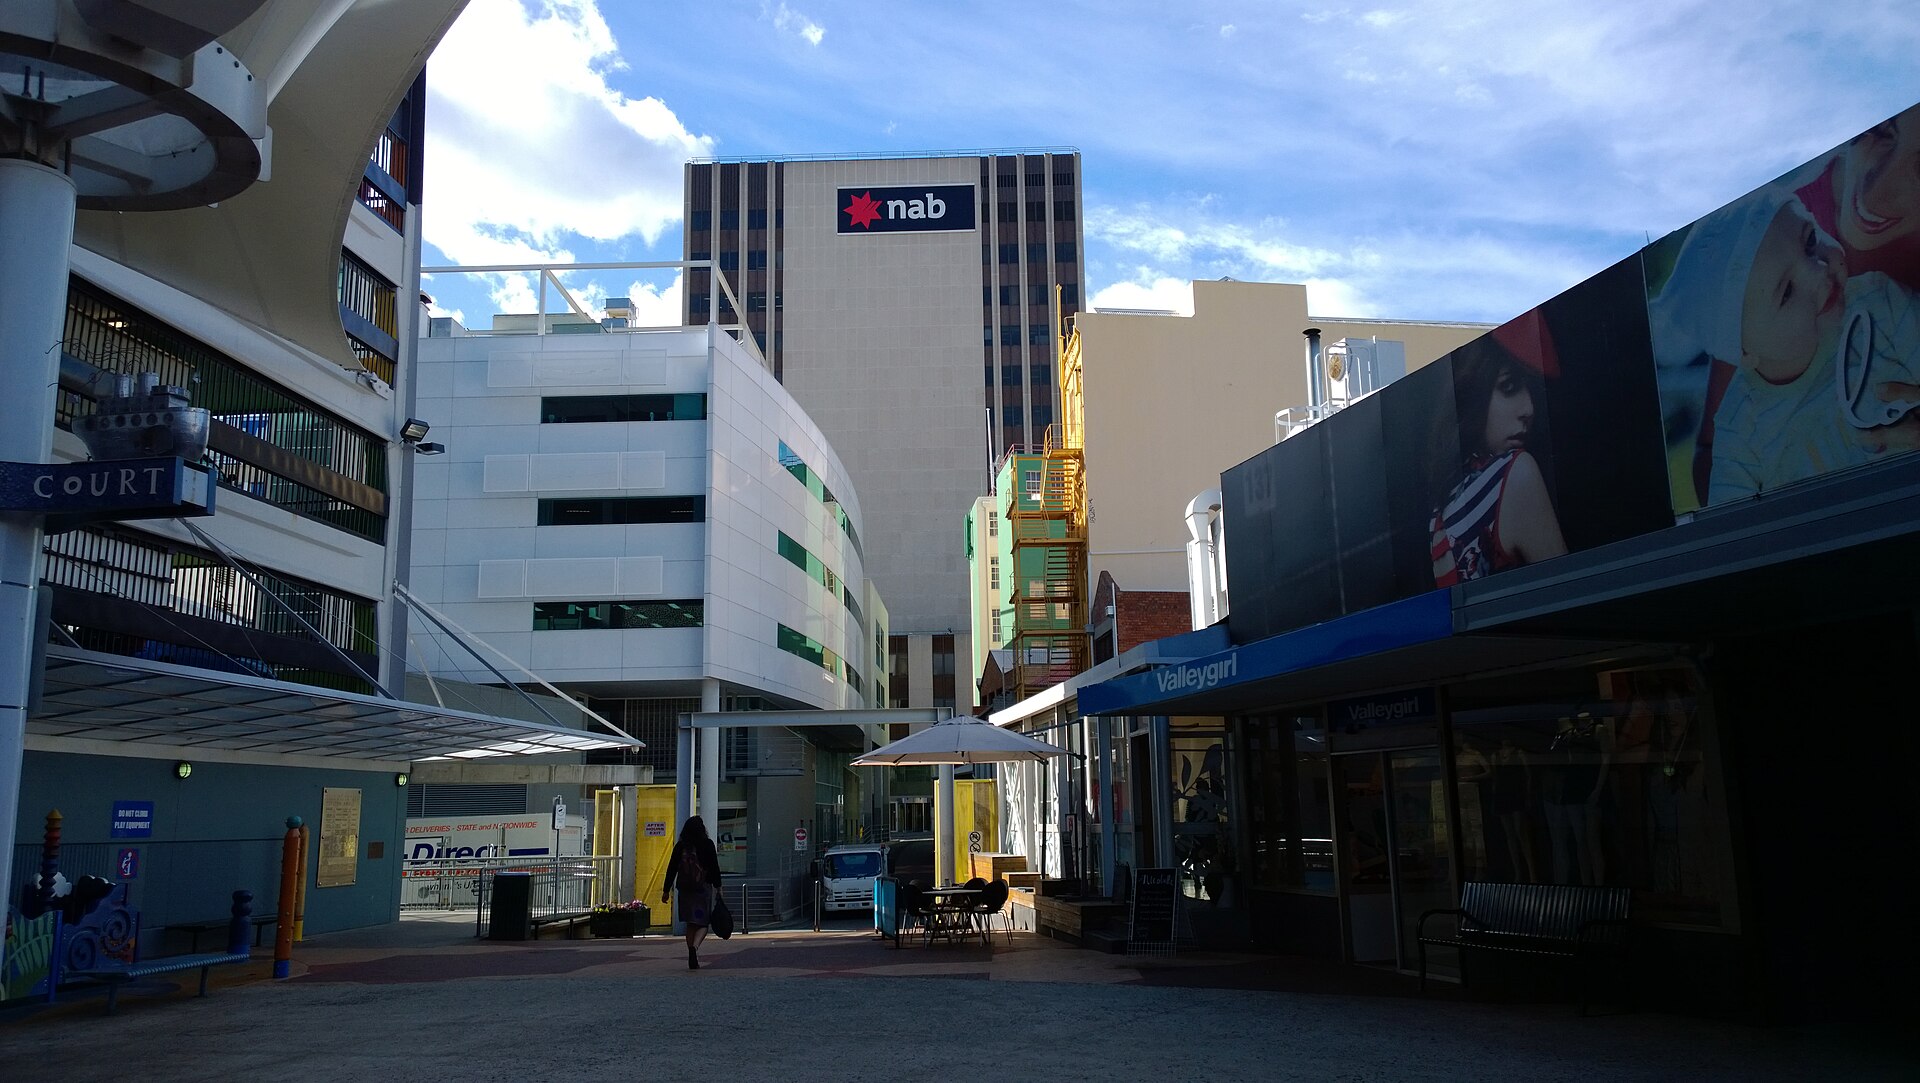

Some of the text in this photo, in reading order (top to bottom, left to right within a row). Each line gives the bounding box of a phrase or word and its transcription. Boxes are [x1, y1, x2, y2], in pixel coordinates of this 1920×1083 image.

[887, 192, 946, 220] nab
[33, 467, 165, 498] COURT
[1157, 652, 1237, 692] Valleygirl
[1348, 696, 1419, 720] Valleygirl
[118, 809, 125, 817] DO
[125, 809, 135, 817] NOT
[114, 821, 150, 830] PLAY EQUIPMENT
[410, 825, 451, 833] DELIVERIES
[493, 821, 538, 830] NTIONWIDE
